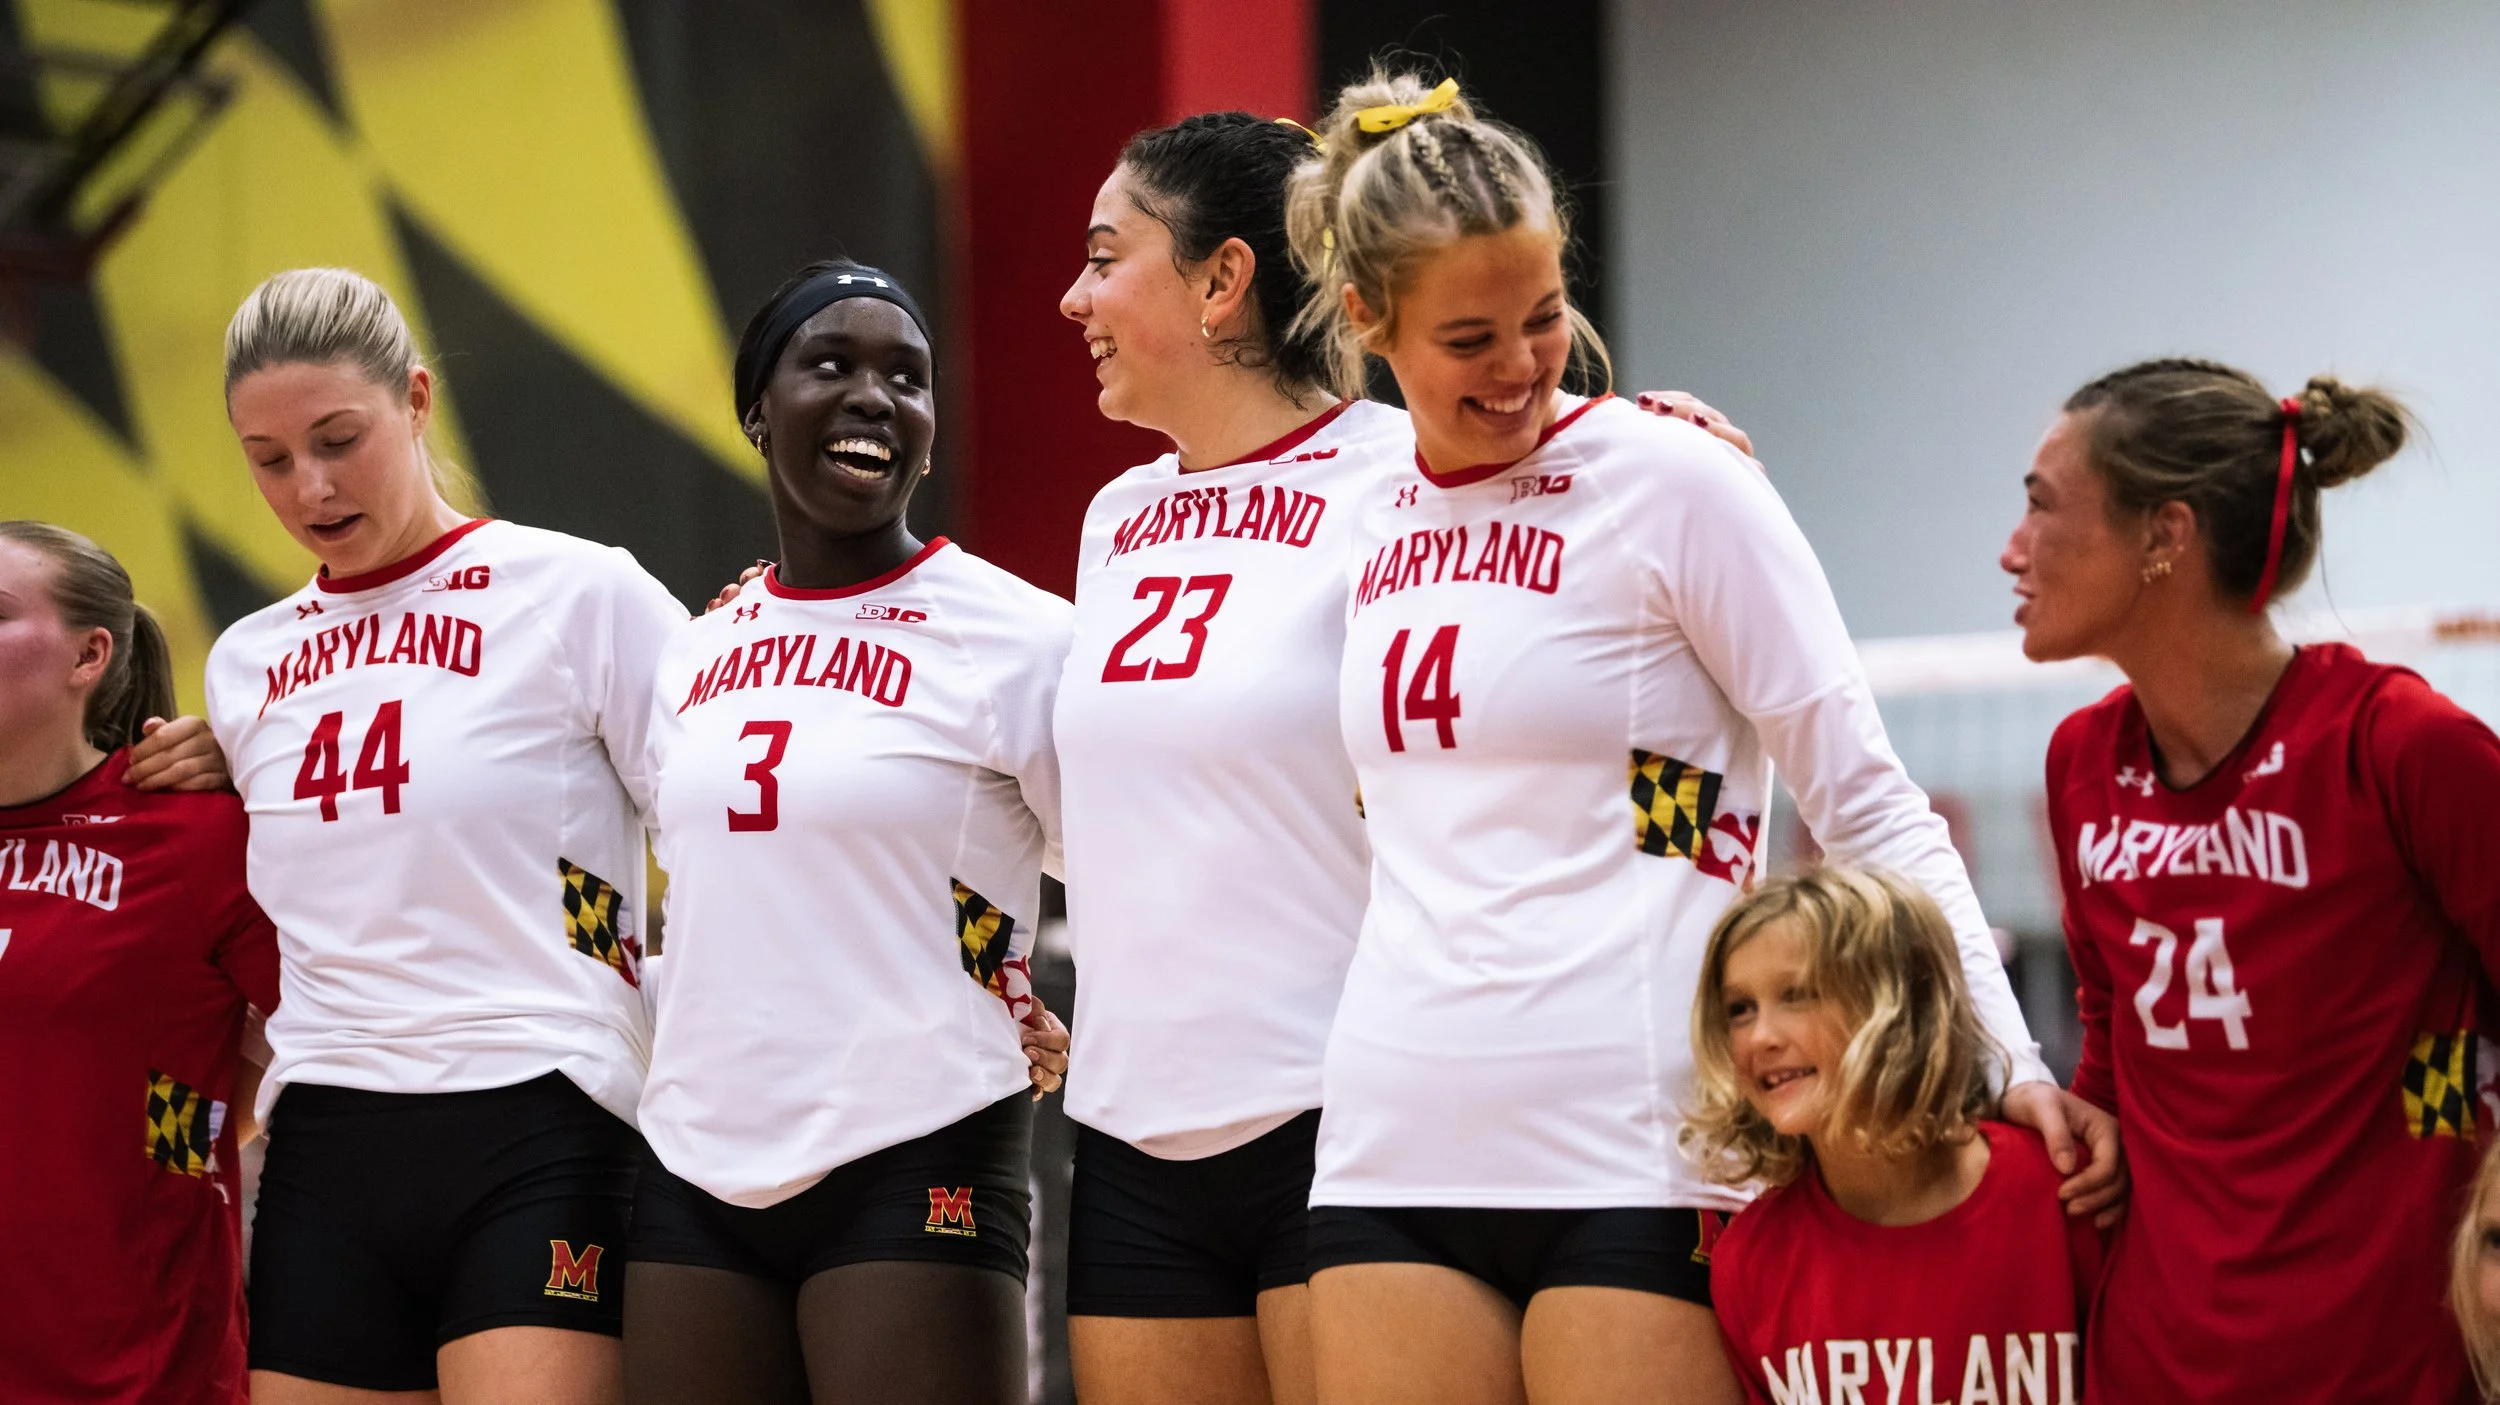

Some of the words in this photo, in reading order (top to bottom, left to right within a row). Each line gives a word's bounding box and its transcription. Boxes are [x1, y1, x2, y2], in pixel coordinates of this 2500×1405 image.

[1105, 484, 1328, 567] MARYLAND
[1353, 519, 1566, 618] MARYLAND
[258, 611, 483, 721] MARYLAND
[676, 634, 913, 716] MARYLAND
[1100, 573, 1233, 684] 23
[1382, 623, 1462, 754] 14
[293, 699, 410, 823] 44
[727, 719, 793, 833] 3
[2078, 806, 2310, 889] MARYLAND
[2129, 917, 2251, 1051] 24
[926, 1186, 977, 1229] M
[545, 1239, 604, 1295] M
